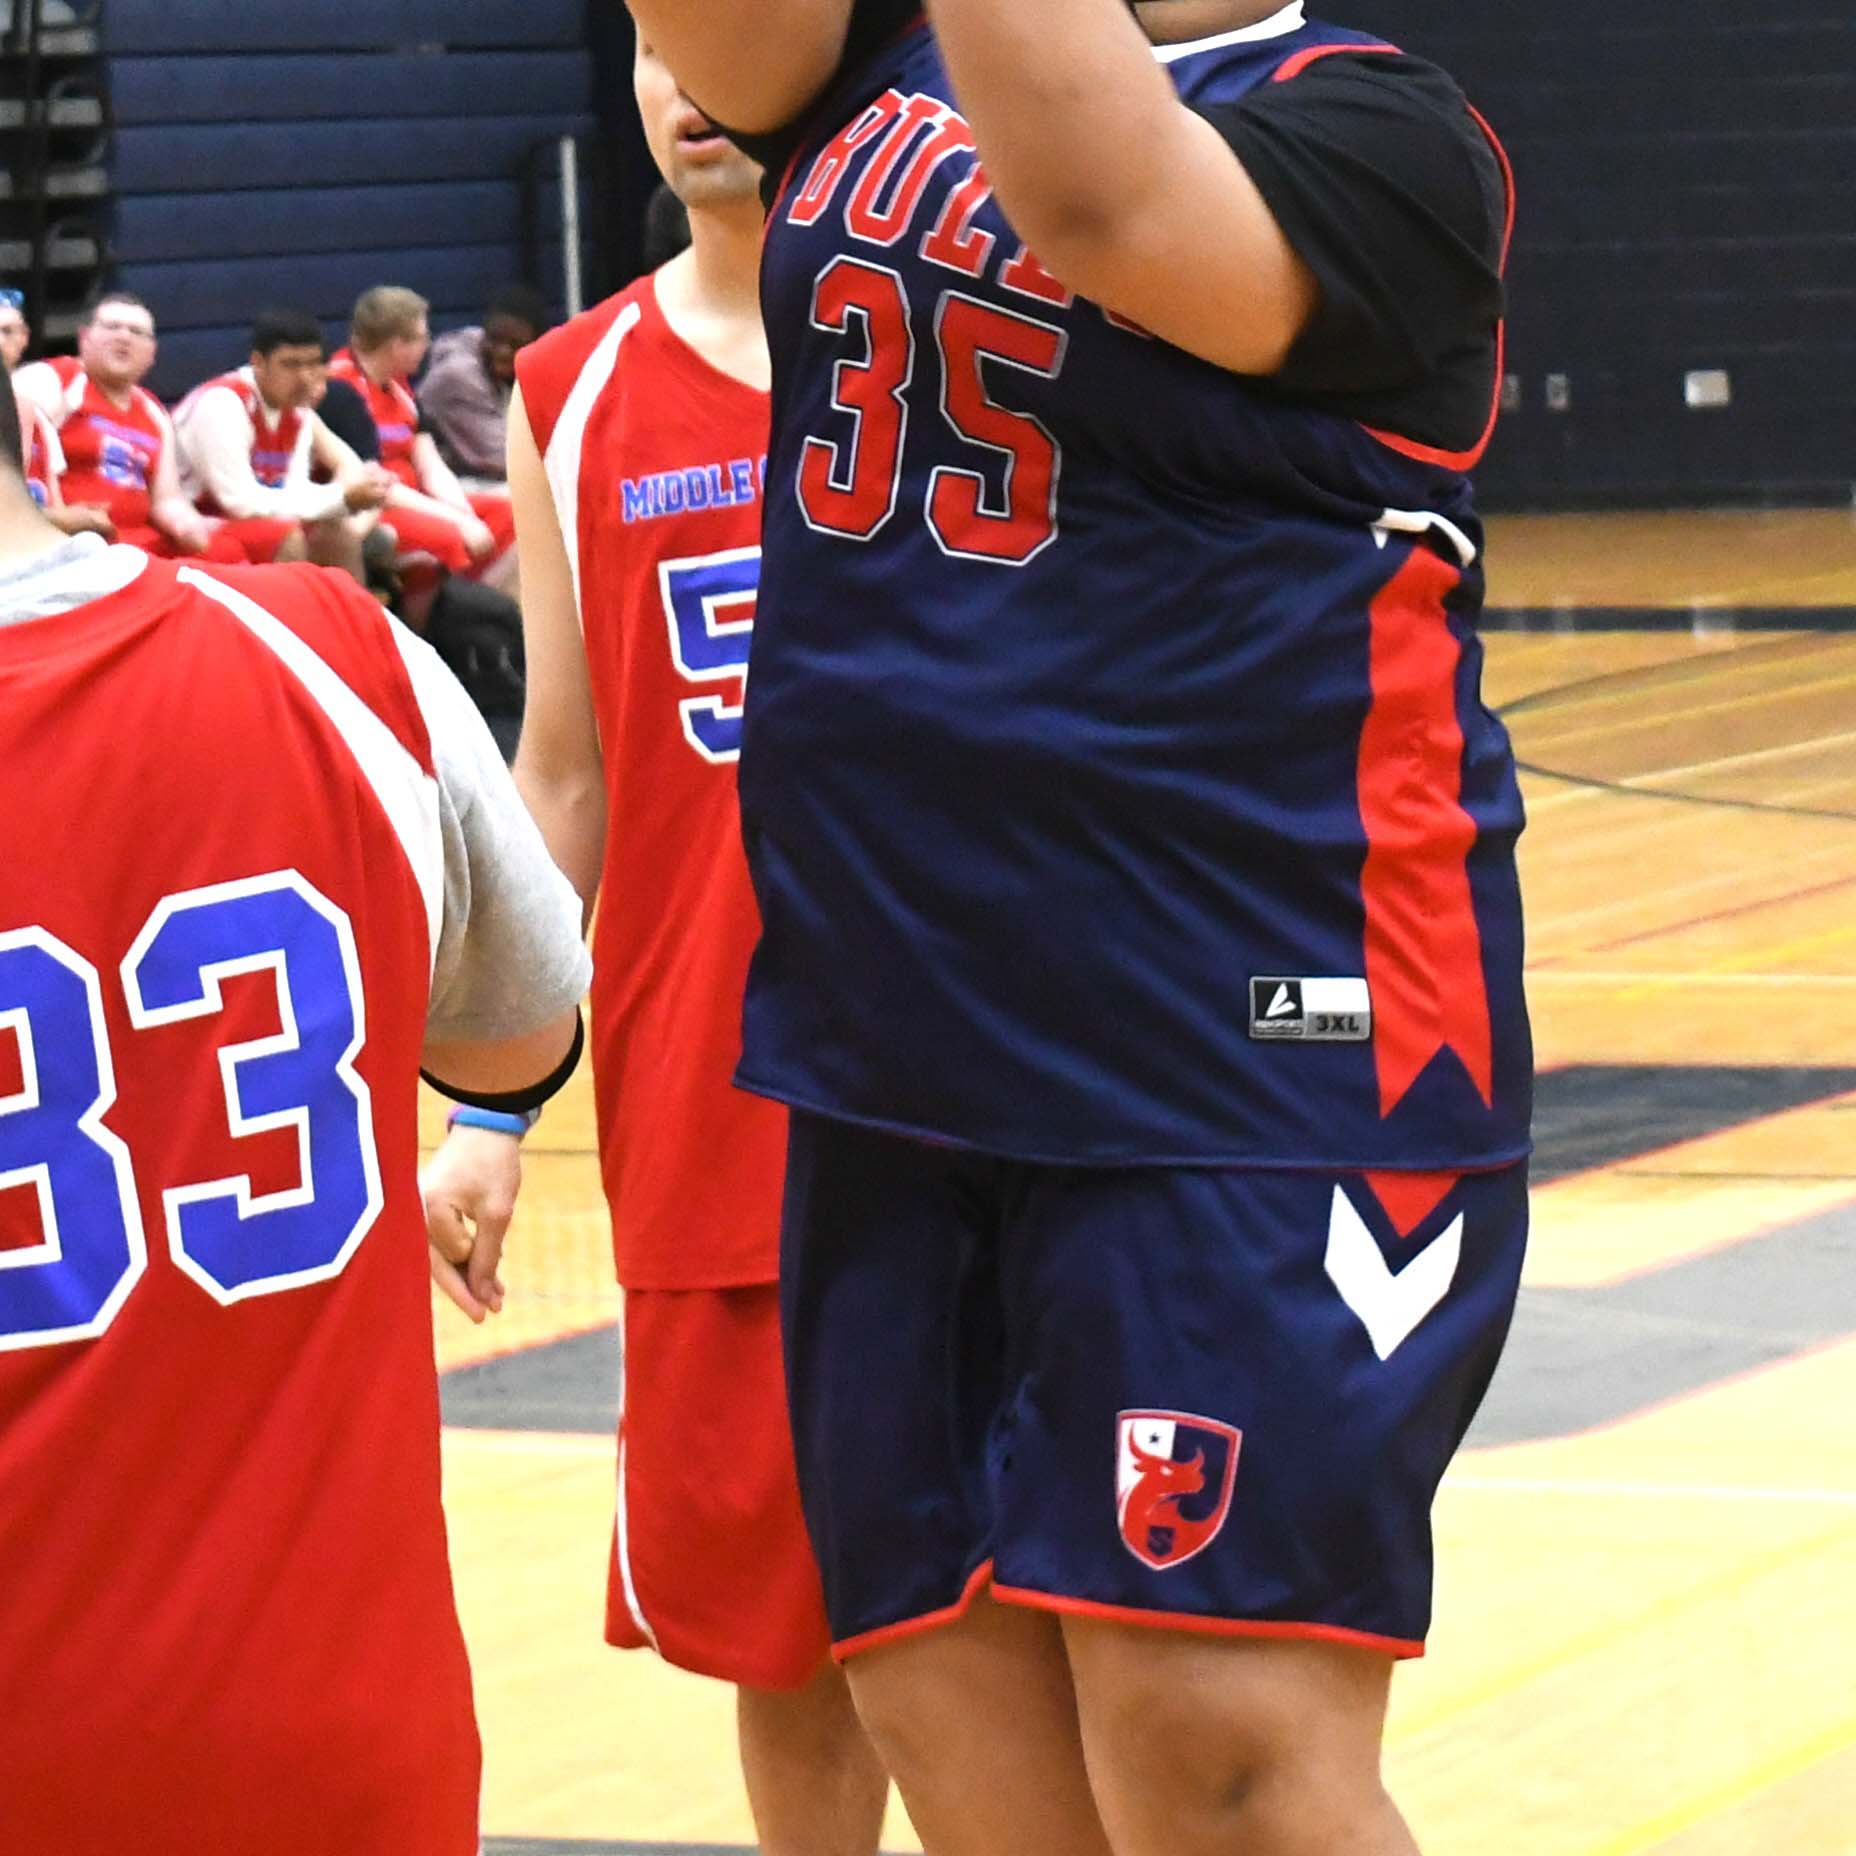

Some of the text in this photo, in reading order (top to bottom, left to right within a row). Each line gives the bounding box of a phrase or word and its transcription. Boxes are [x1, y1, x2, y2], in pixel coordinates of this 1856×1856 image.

[795, 254, 1069, 567] 35
[621, 458, 755, 524] MIDDLE
[1316, 1015, 1360, 1033] 3XL
